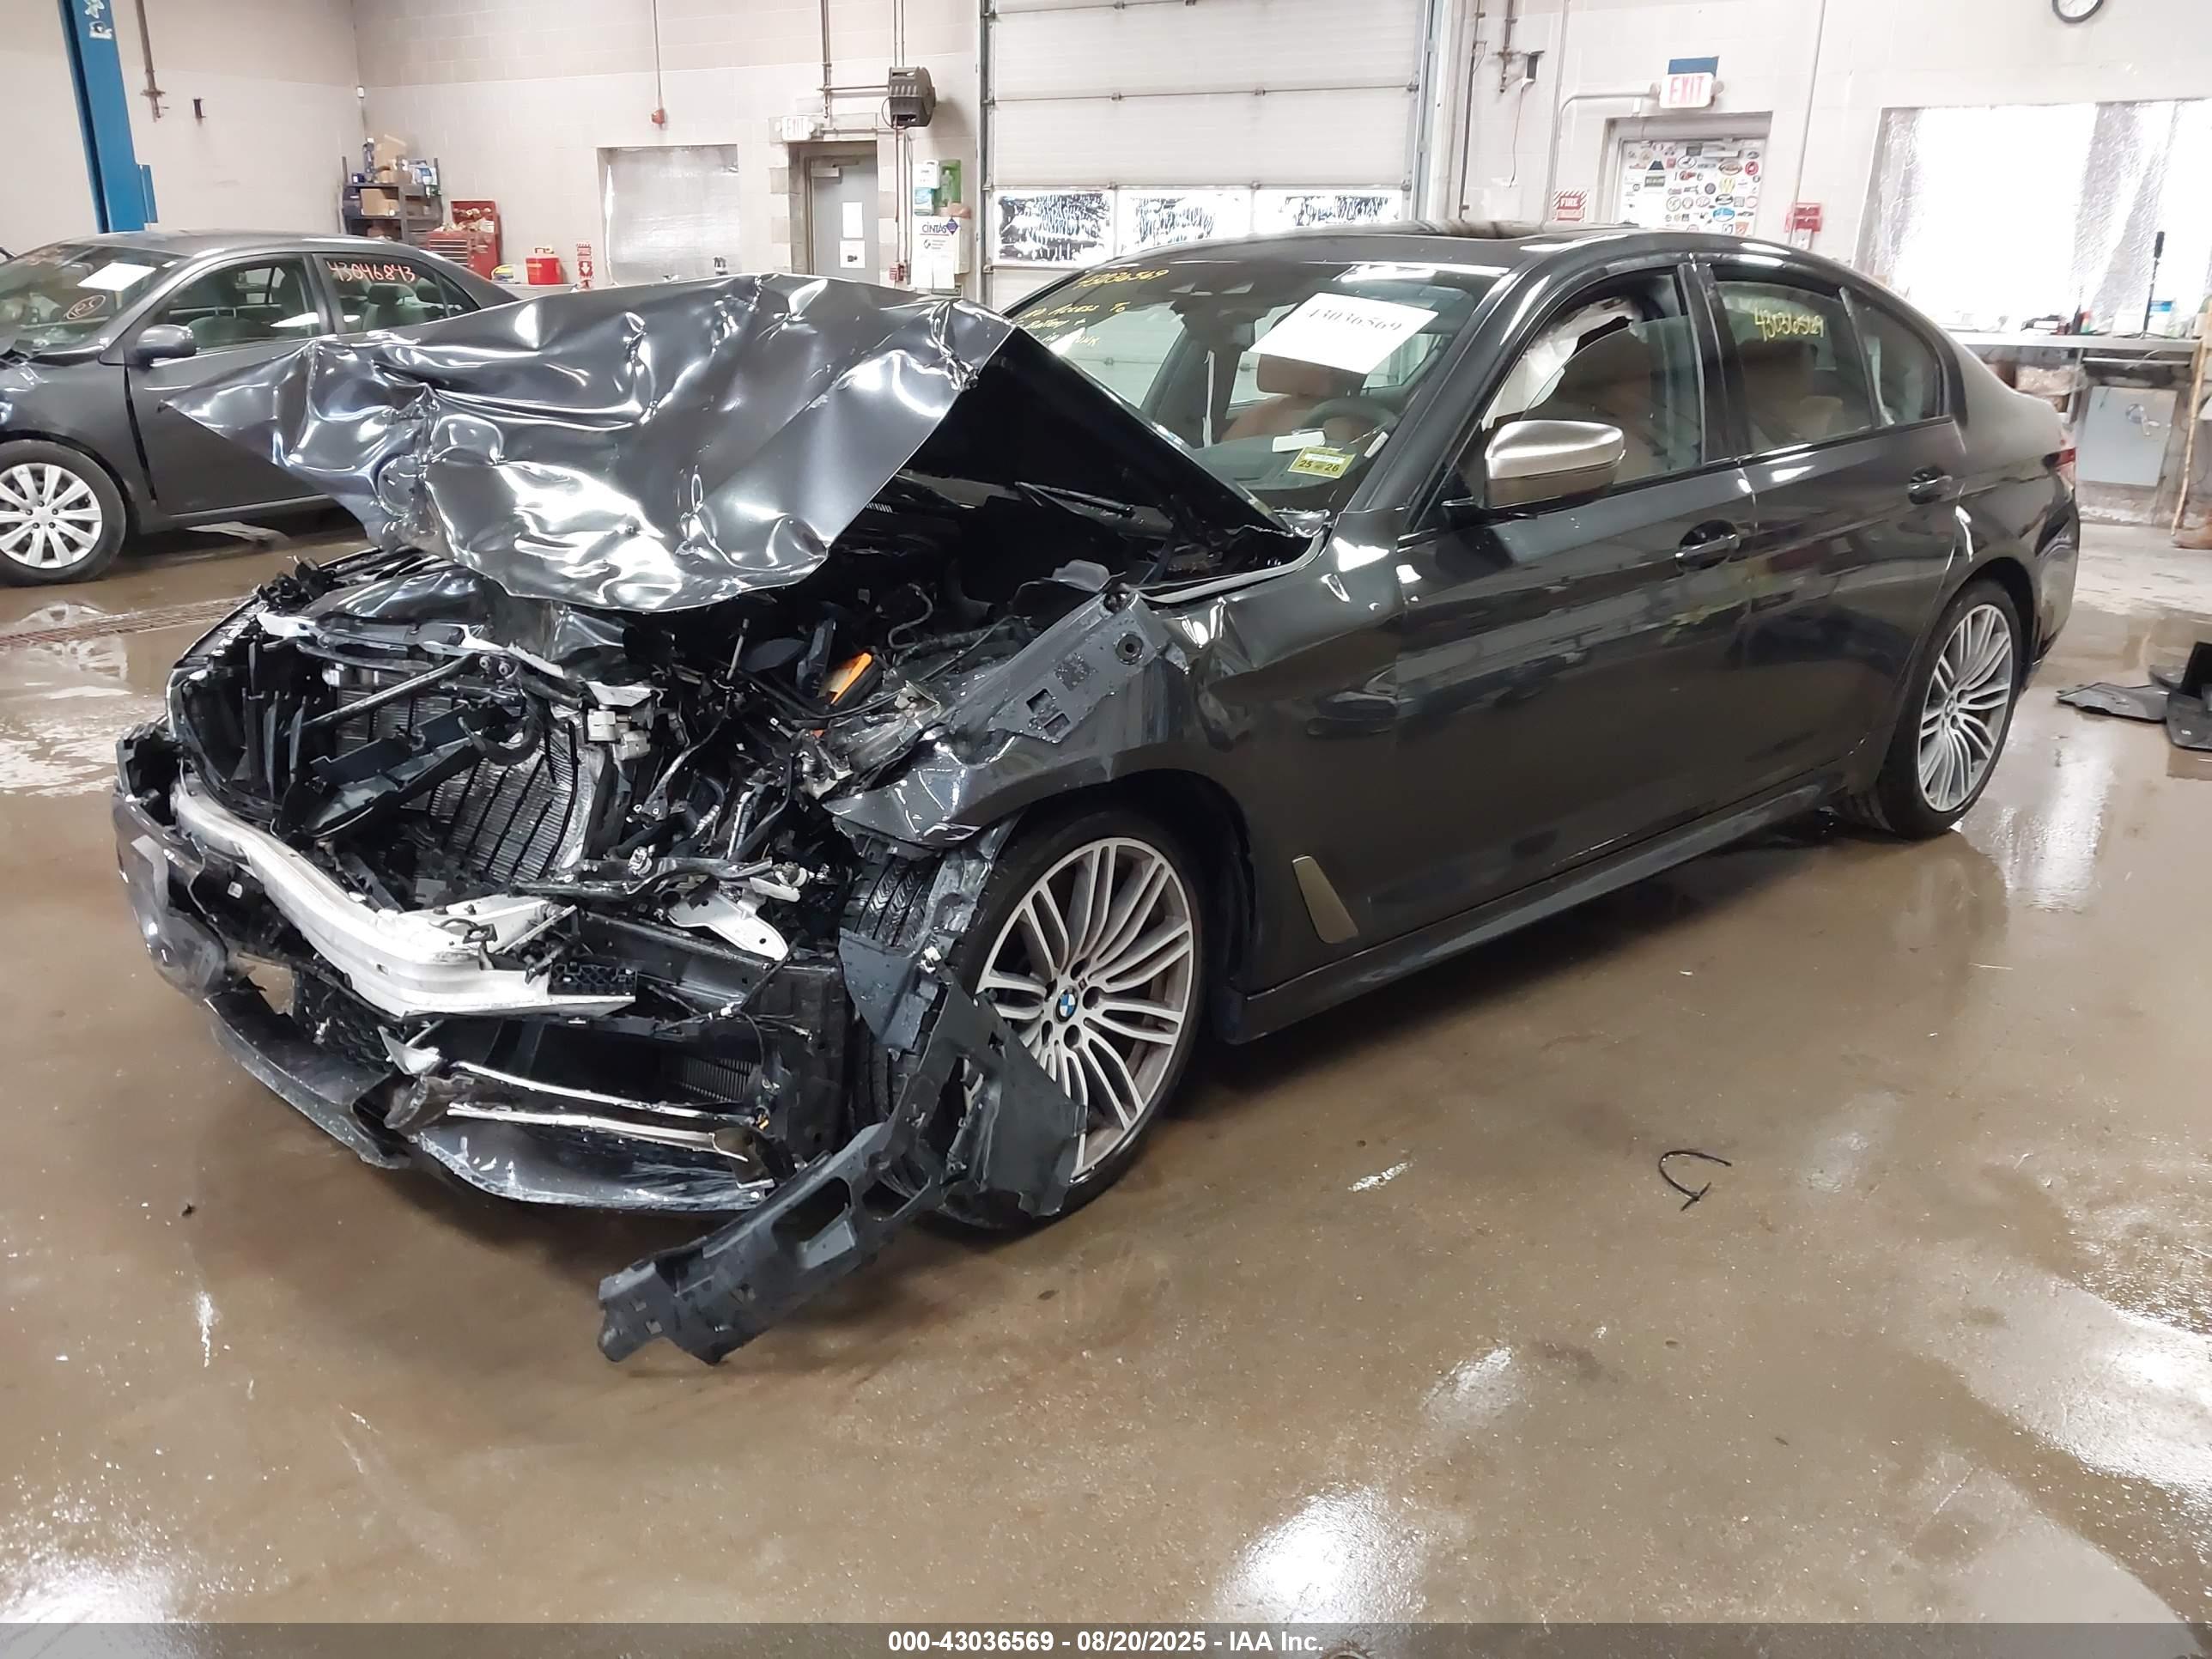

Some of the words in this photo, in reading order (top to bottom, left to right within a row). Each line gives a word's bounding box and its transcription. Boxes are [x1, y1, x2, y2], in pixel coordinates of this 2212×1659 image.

[1668, 76, 1705, 105] EXIT
[326, 261, 416, 283] 43046843
[1298, 459, 1313, 469] 25
[1325, 463, 1340, 472] 26
